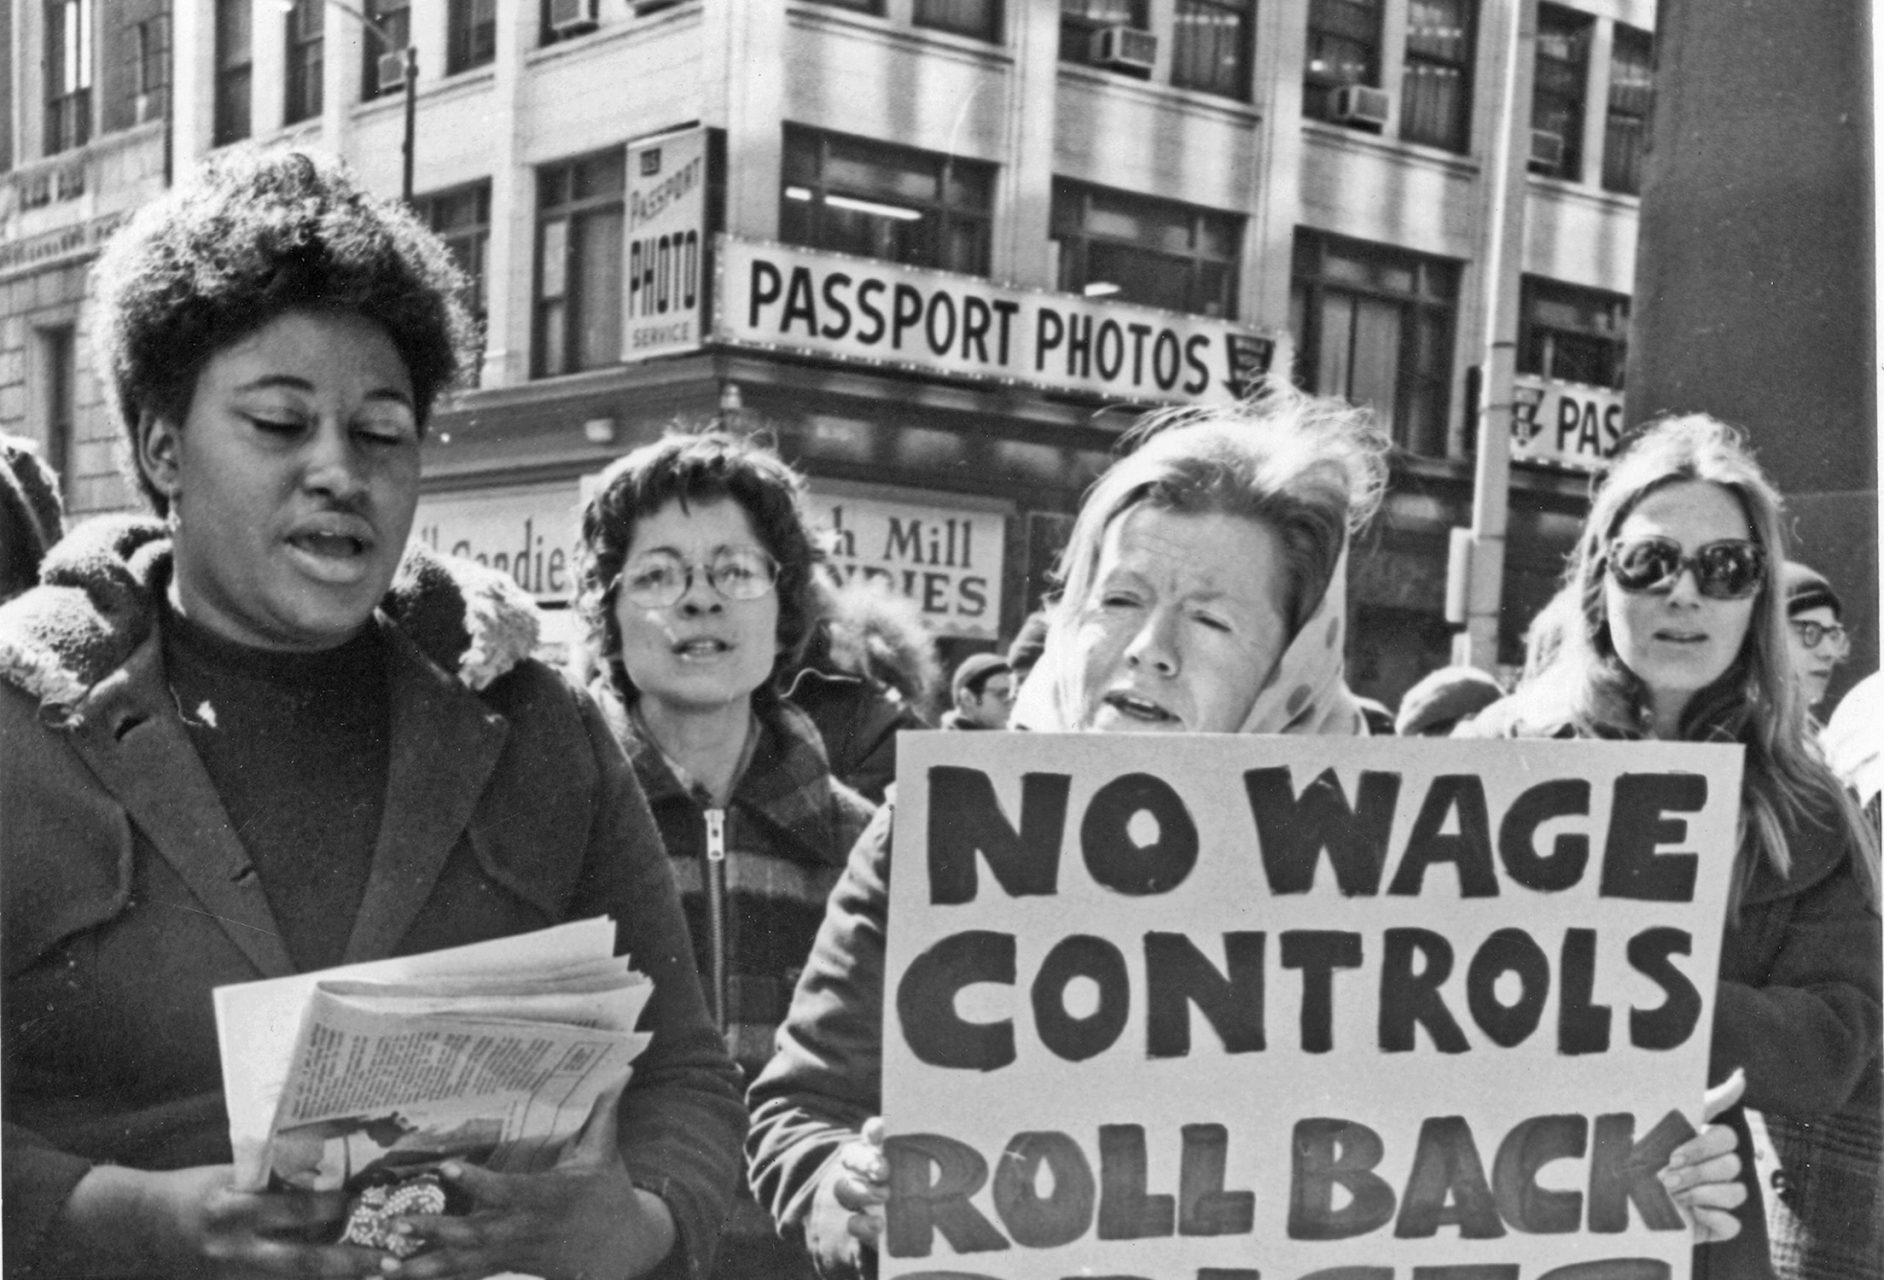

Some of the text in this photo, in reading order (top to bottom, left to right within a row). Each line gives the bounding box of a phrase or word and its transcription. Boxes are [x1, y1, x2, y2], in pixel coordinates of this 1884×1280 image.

[629, 229, 698, 319] PHOTO
[748, 259, 1020, 368] PASSPORT
[1035, 307, 1211, 395] PHOTOS
[1556, 395, 1622, 459] PAS
[883, 517, 973, 569] Mill
[926, 765, 1709, 905] NO WAGE
[895, 927, 1702, 1072] CONTROLS
[883, 1109, 1702, 1258] ROLL BACK
